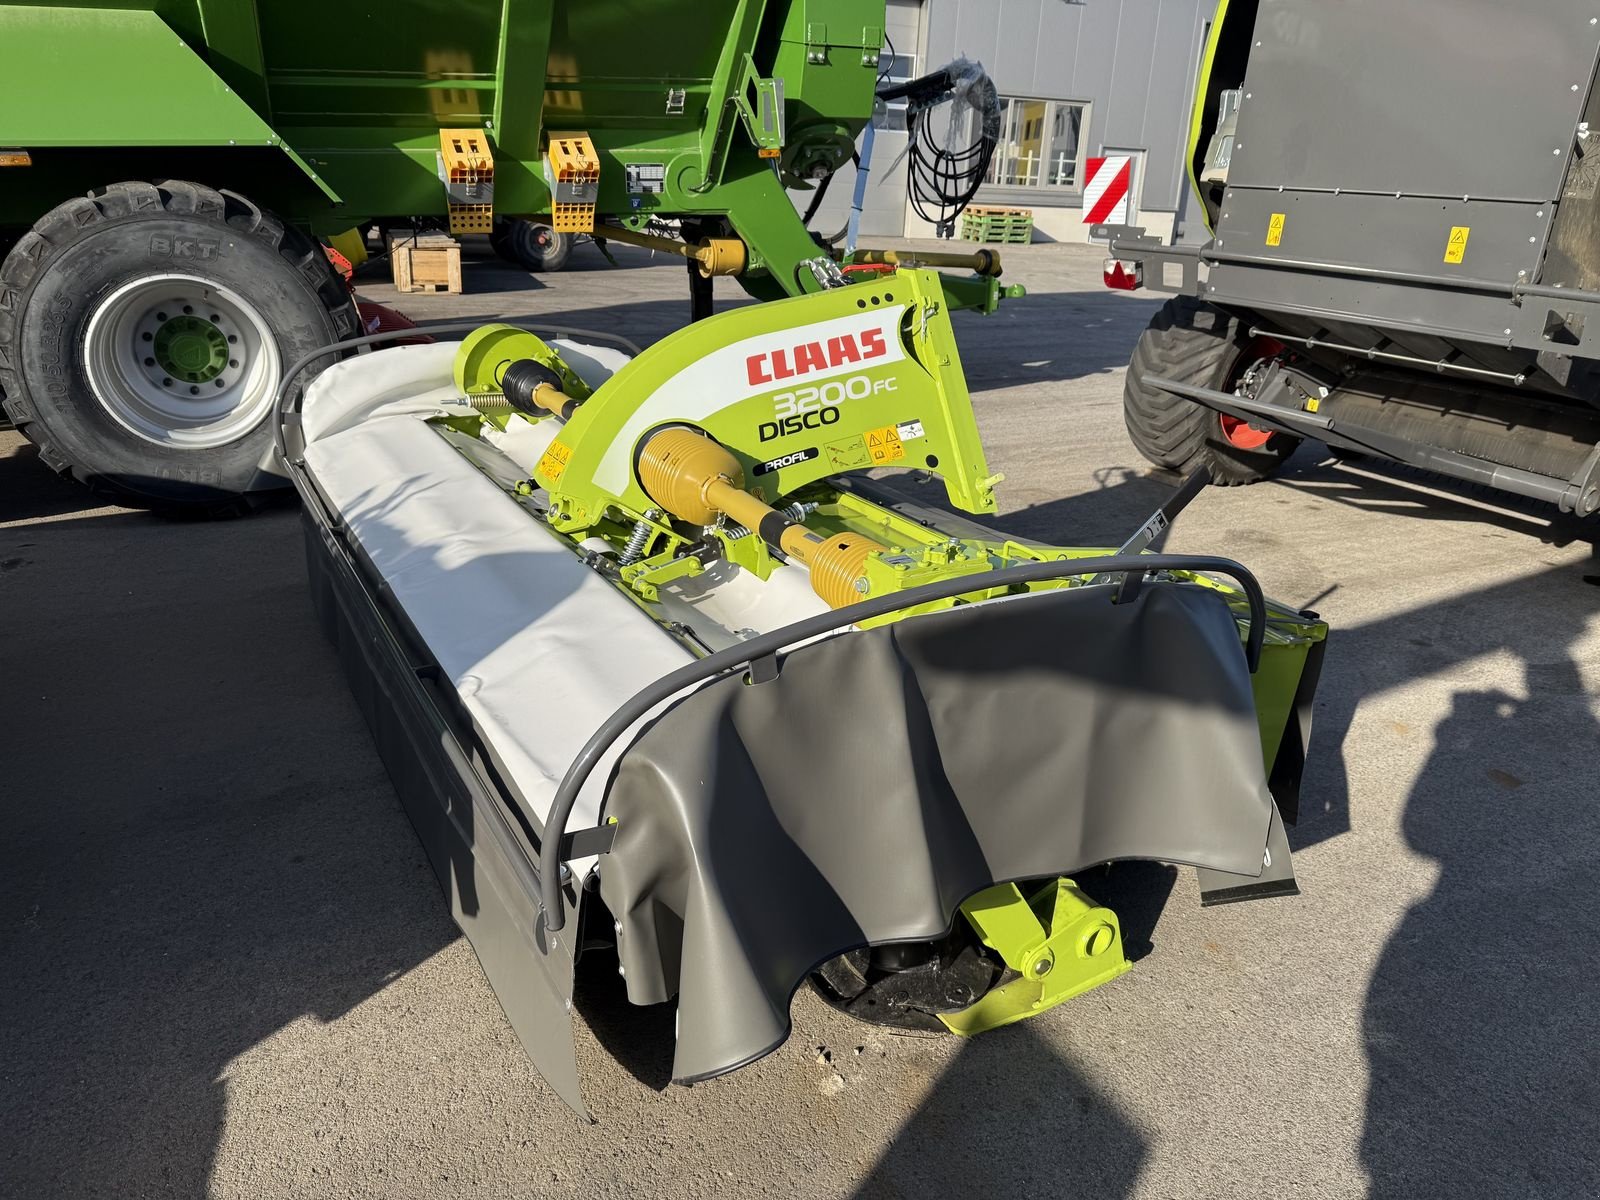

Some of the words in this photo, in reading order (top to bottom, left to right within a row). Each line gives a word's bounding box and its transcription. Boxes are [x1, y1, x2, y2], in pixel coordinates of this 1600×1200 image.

[151, 238, 217, 258] BKT
[746, 327, 887, 386] CLAAS
[758, 406, 840, 443] DISCO
[764, 451, 809, 473] PROFIL
